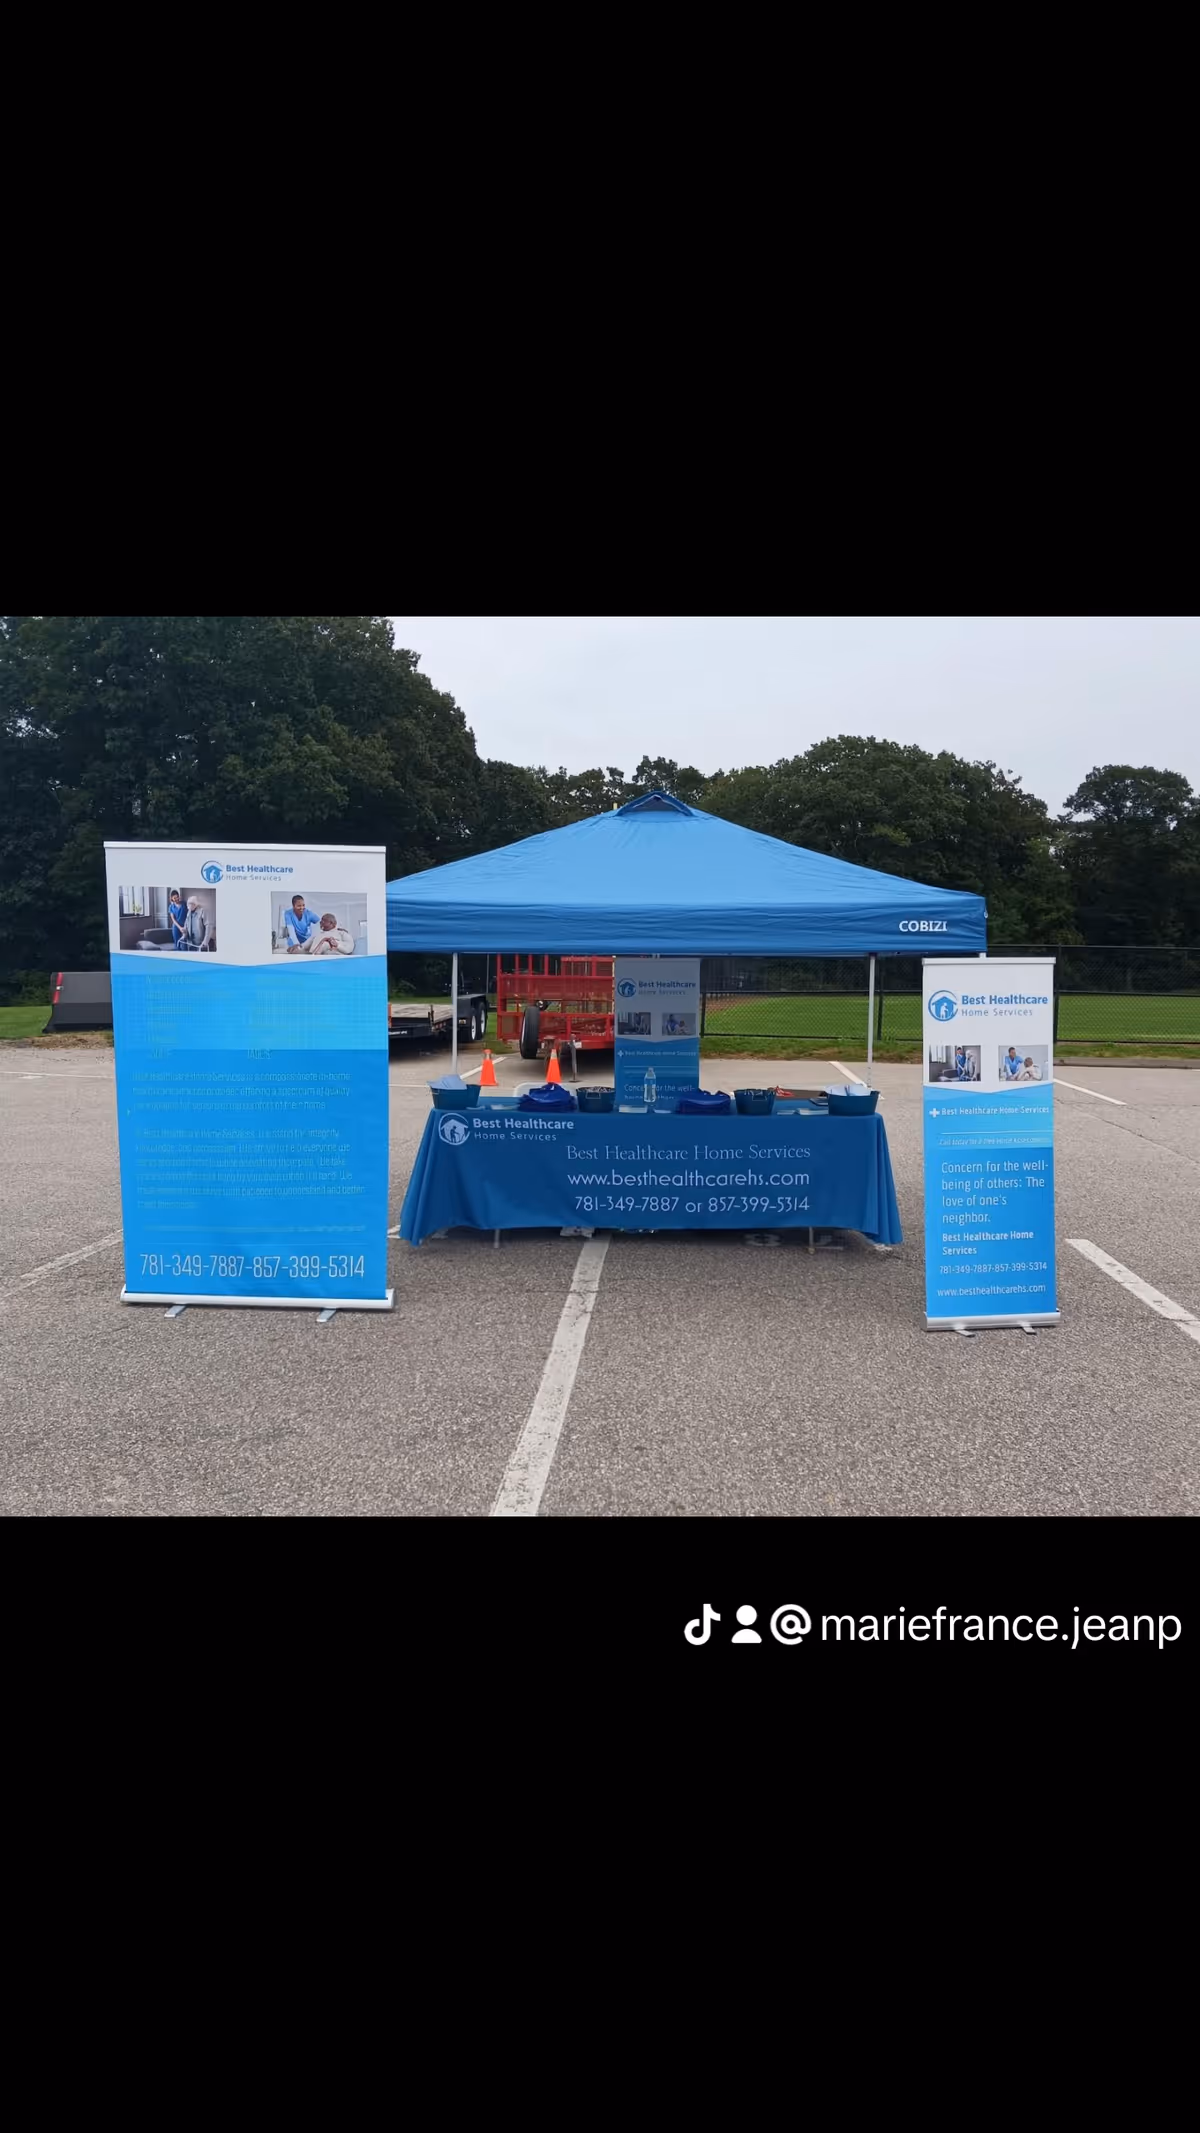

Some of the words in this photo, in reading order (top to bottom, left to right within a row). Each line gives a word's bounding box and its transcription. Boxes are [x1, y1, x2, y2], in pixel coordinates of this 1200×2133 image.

[225, 864, 245, 873] Best
[247, 865, 294, 874] Healthcare
[249, 874, 282, 882] Services
[899, 920, 948, 932] COBIZI
[638, 980, 655, 988] Best
[656, 980, 696, 989] Healthcare
[961, 995, 986, 1005] Best
[989, 994, 1049, 1005] Healthcare
[961, 1009, 989, 1017] Home
[993, 1008, 1033, 1017] Services
[941, 1107, 957, 1115] Best
[959, 1104, 998, 1115] Healthcare
[1000, 1105, 1018, 1114] Home
[1020, 1104, 1050, 1114] Services
[473, 1118, 501, 1128] Best
[504, 1118, 575, 1129] Healthcare
[474, 1132, 506, 1140] Home
[510, 1132, 557, 1141] Services
[567, 1146, 599, 1160] Best
[605, 1146, 689, 1160] Healthcare
[694, 1145, 744, 1160] Home
[749, 1145, 811, 1158] Services
[941, 1161, 983, 1174] Concern
[986, 1161, 1001, 1172] for
[1003, 1160, 1020, 1172] the
[1022, 1159, 1049, 1171] well-
[567, 1169, 810, 1187] www.besthealthcarehs.com
[941, 1180, 971, 1192] being
[973, 1178, 985, 1189] of
[987, 1177, 1022, 1189] others:
[1025, 1176, 1045, 1188] The
[575, 1196, 679, 1212] 781-349-7887
[685, 1201, 702, 1213] or
[708, 1196, 810, 1212] 857-399-5314
[942, 1196, 964, 1207] love
[966, 1195, 977, 1206] of
[979, 1194, 1007, 1206] one's
[942, 1212, 991, 1226] neighbor.
[942, 1233, 961, 1242] Best
[963, 1231, 1008, 1241] Healthcare
[1010, 1230, 1034, 1239] Home
[942, 1246, 977, 1256] Services
[140, 1253, 366, 1279] 781-349-7887-857-399-5314
[939, 1262, 1048, 1275] 781-349-7887-857-399-5314
[937, 1284, 1046, 1297] www.besthealthcarehs.com
